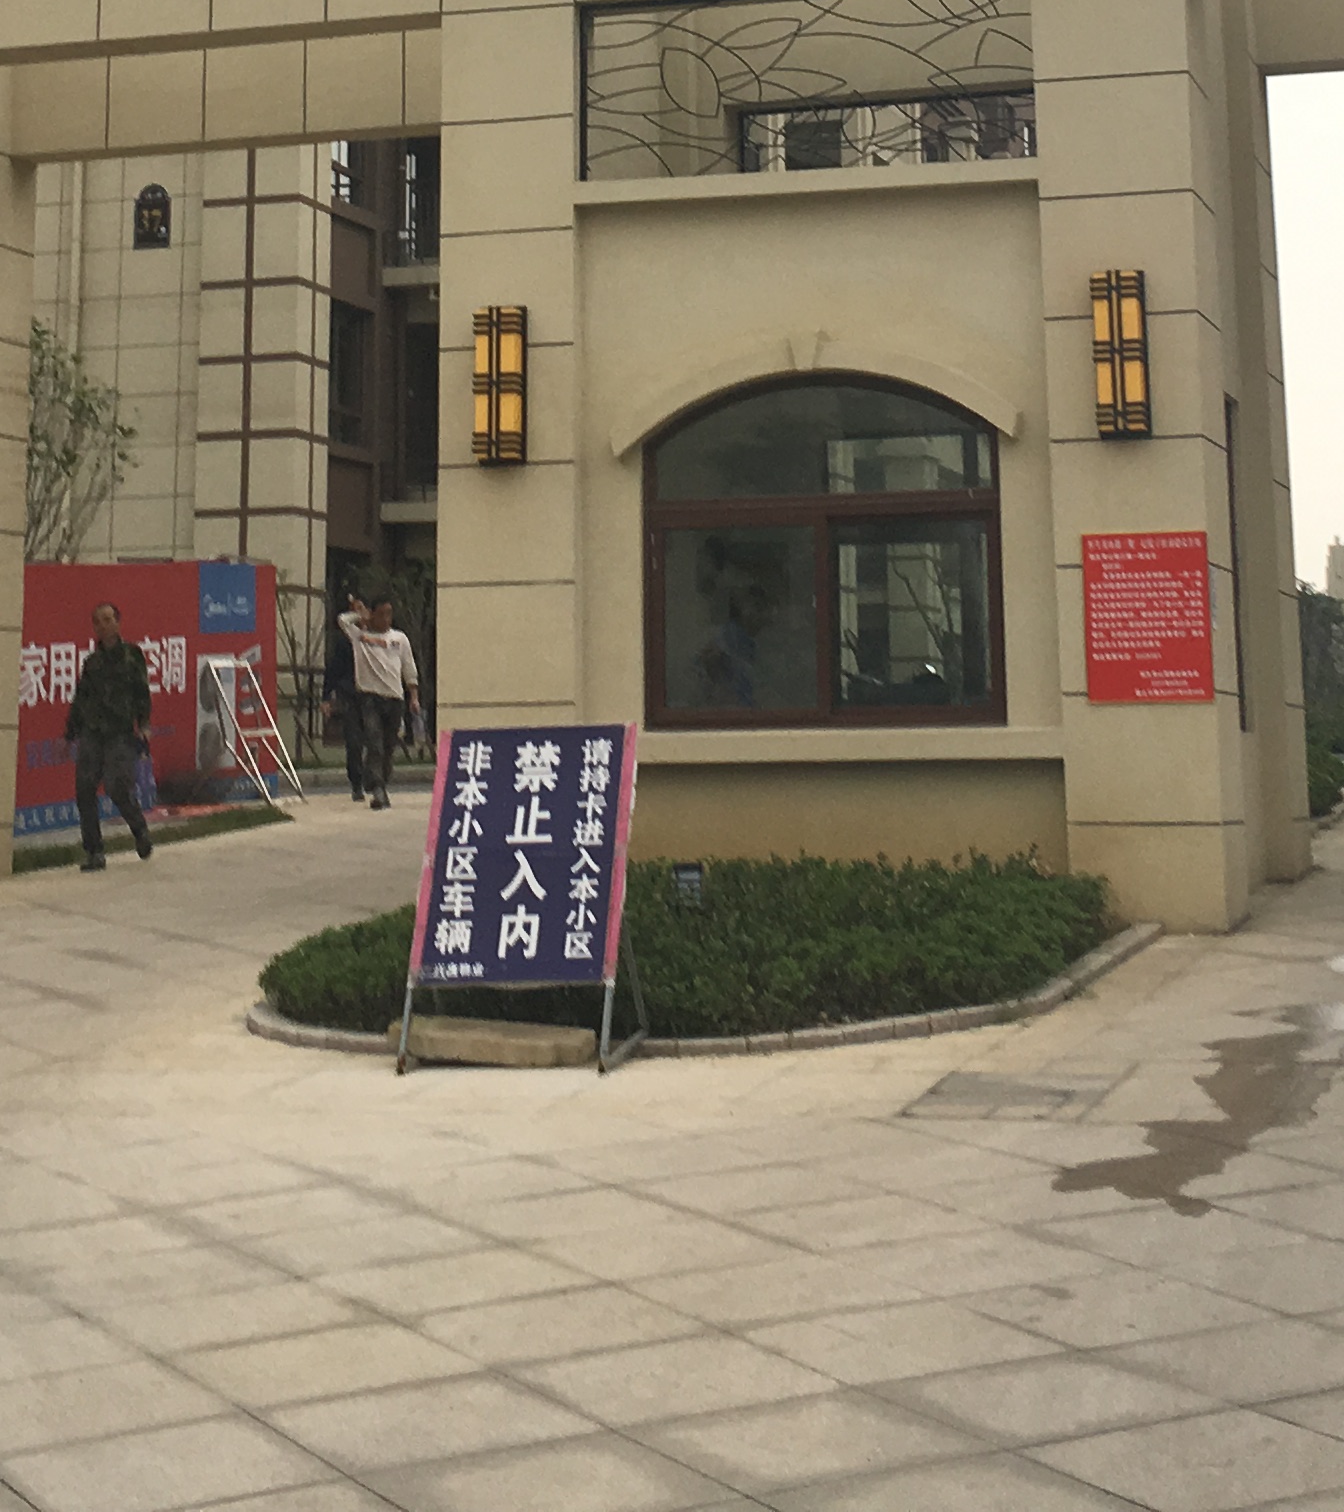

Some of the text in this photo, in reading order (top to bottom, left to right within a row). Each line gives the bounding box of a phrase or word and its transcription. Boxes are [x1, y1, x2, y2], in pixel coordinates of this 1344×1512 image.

[434, 740, 493, 955] 非本小区车辆
[497, 740, 561, 960] 禁止入内
[564, 737, 613, 960] 请持卡进入本小区
